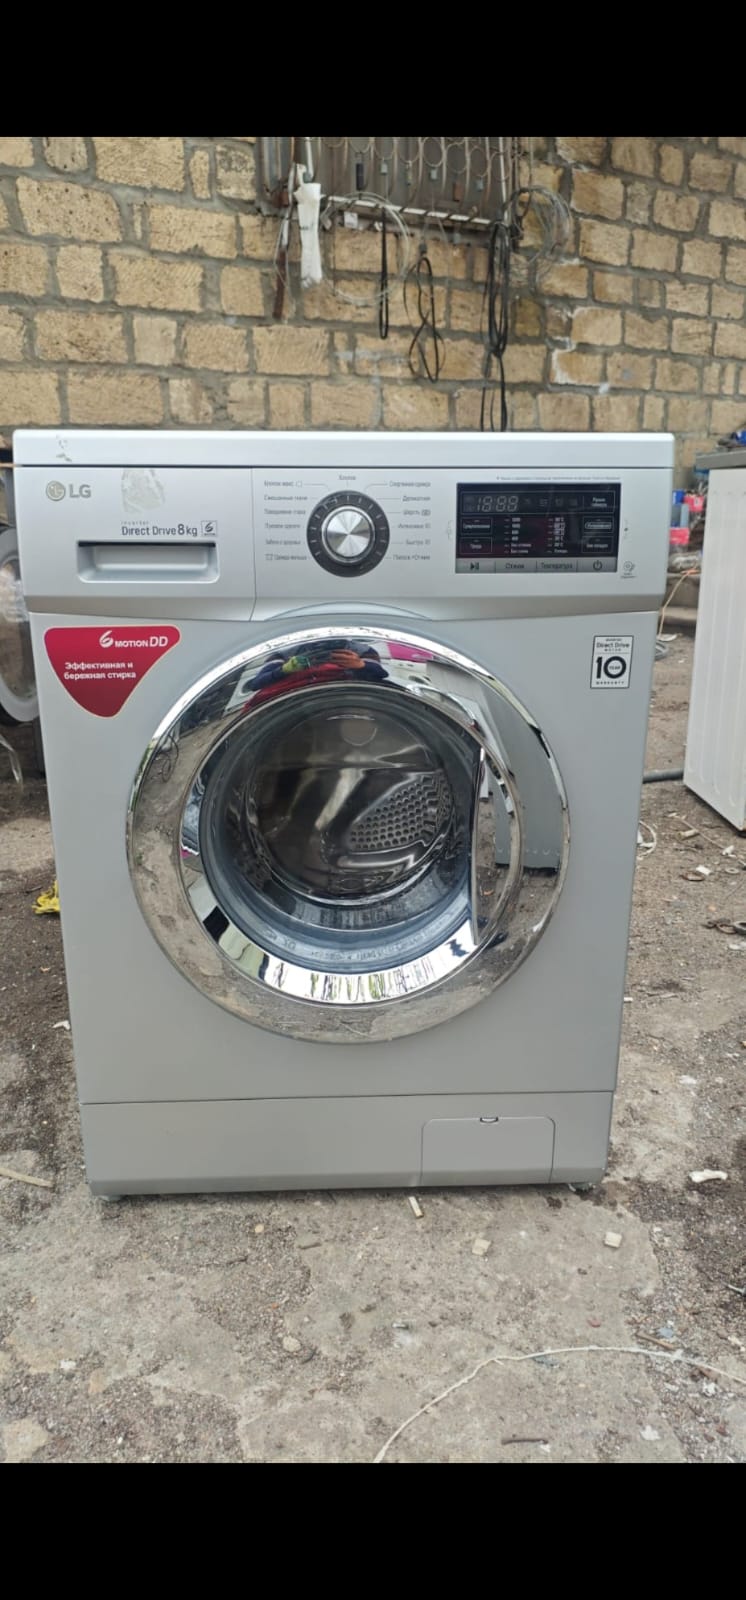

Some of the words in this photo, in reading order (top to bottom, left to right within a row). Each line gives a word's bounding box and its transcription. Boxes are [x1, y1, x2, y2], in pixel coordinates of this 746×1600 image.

[69, 484, 91, 498] LG
[121, 526, 150, 536] Direct
[152, 526, 176, 536] Drive
[114, 639, 149, 648] MOTION
[149, 636, 168, 647] DD
[65, 662, 126, 670] Эффективная
[596, 656, 627, 679] 10
[64, 671, 106, 680] бережная
[107, 671, 136, 679] стирка
